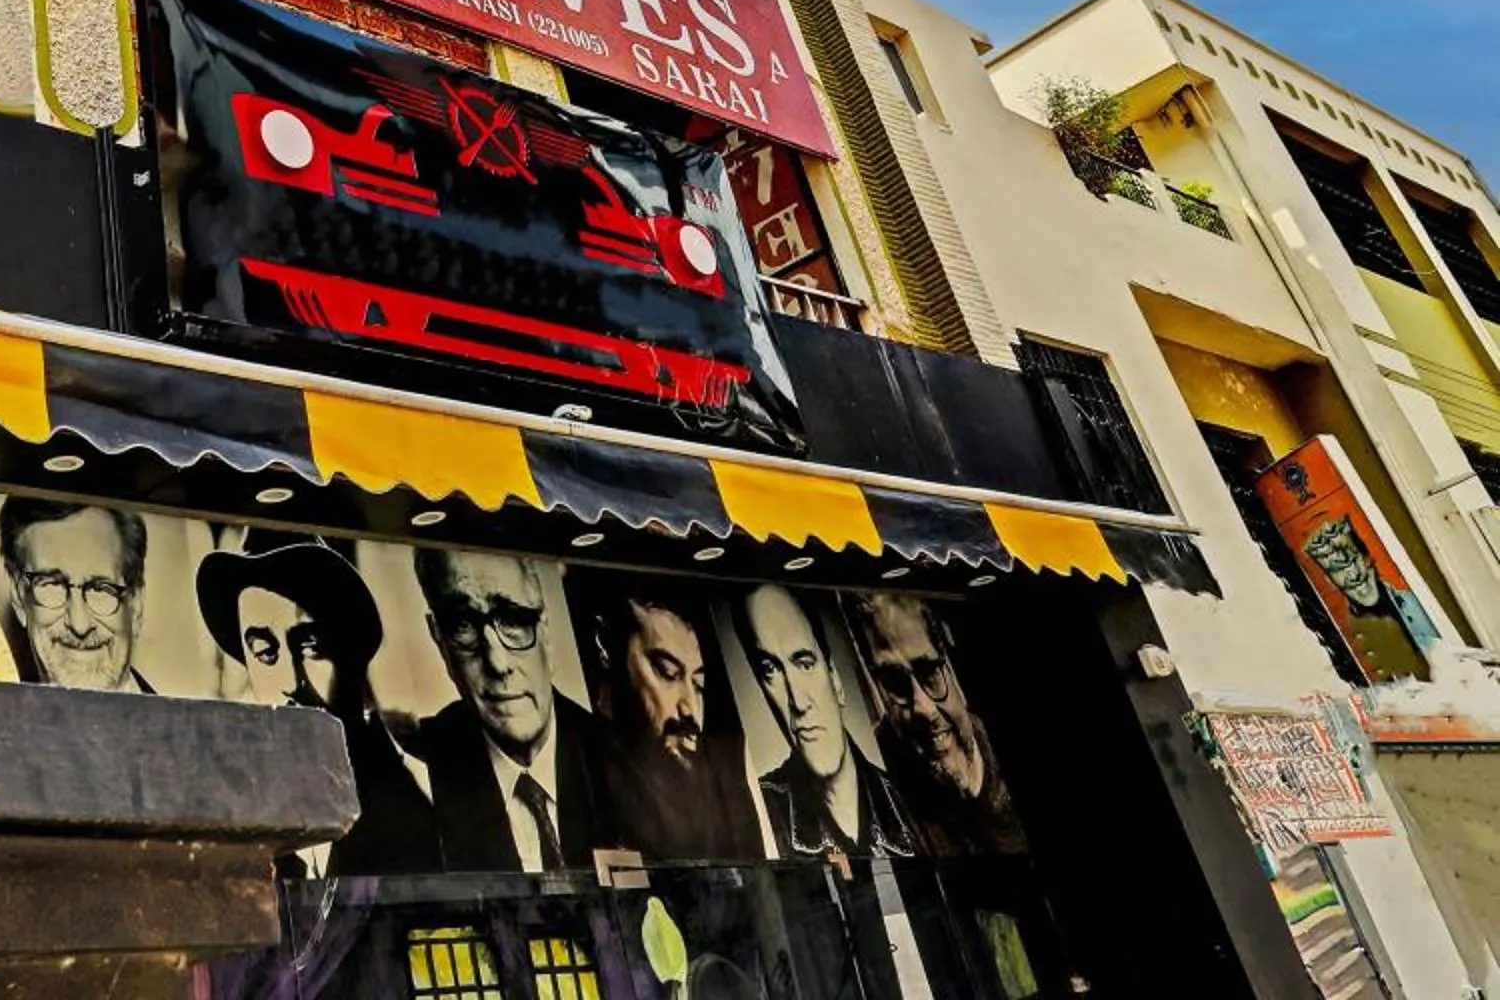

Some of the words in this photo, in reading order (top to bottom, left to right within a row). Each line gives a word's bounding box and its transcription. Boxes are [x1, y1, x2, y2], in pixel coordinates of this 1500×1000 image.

[527, 10, 610, 58] (221005)
[631, 42, 770, 125] SARAI
[770, 51, 789, 84] A
